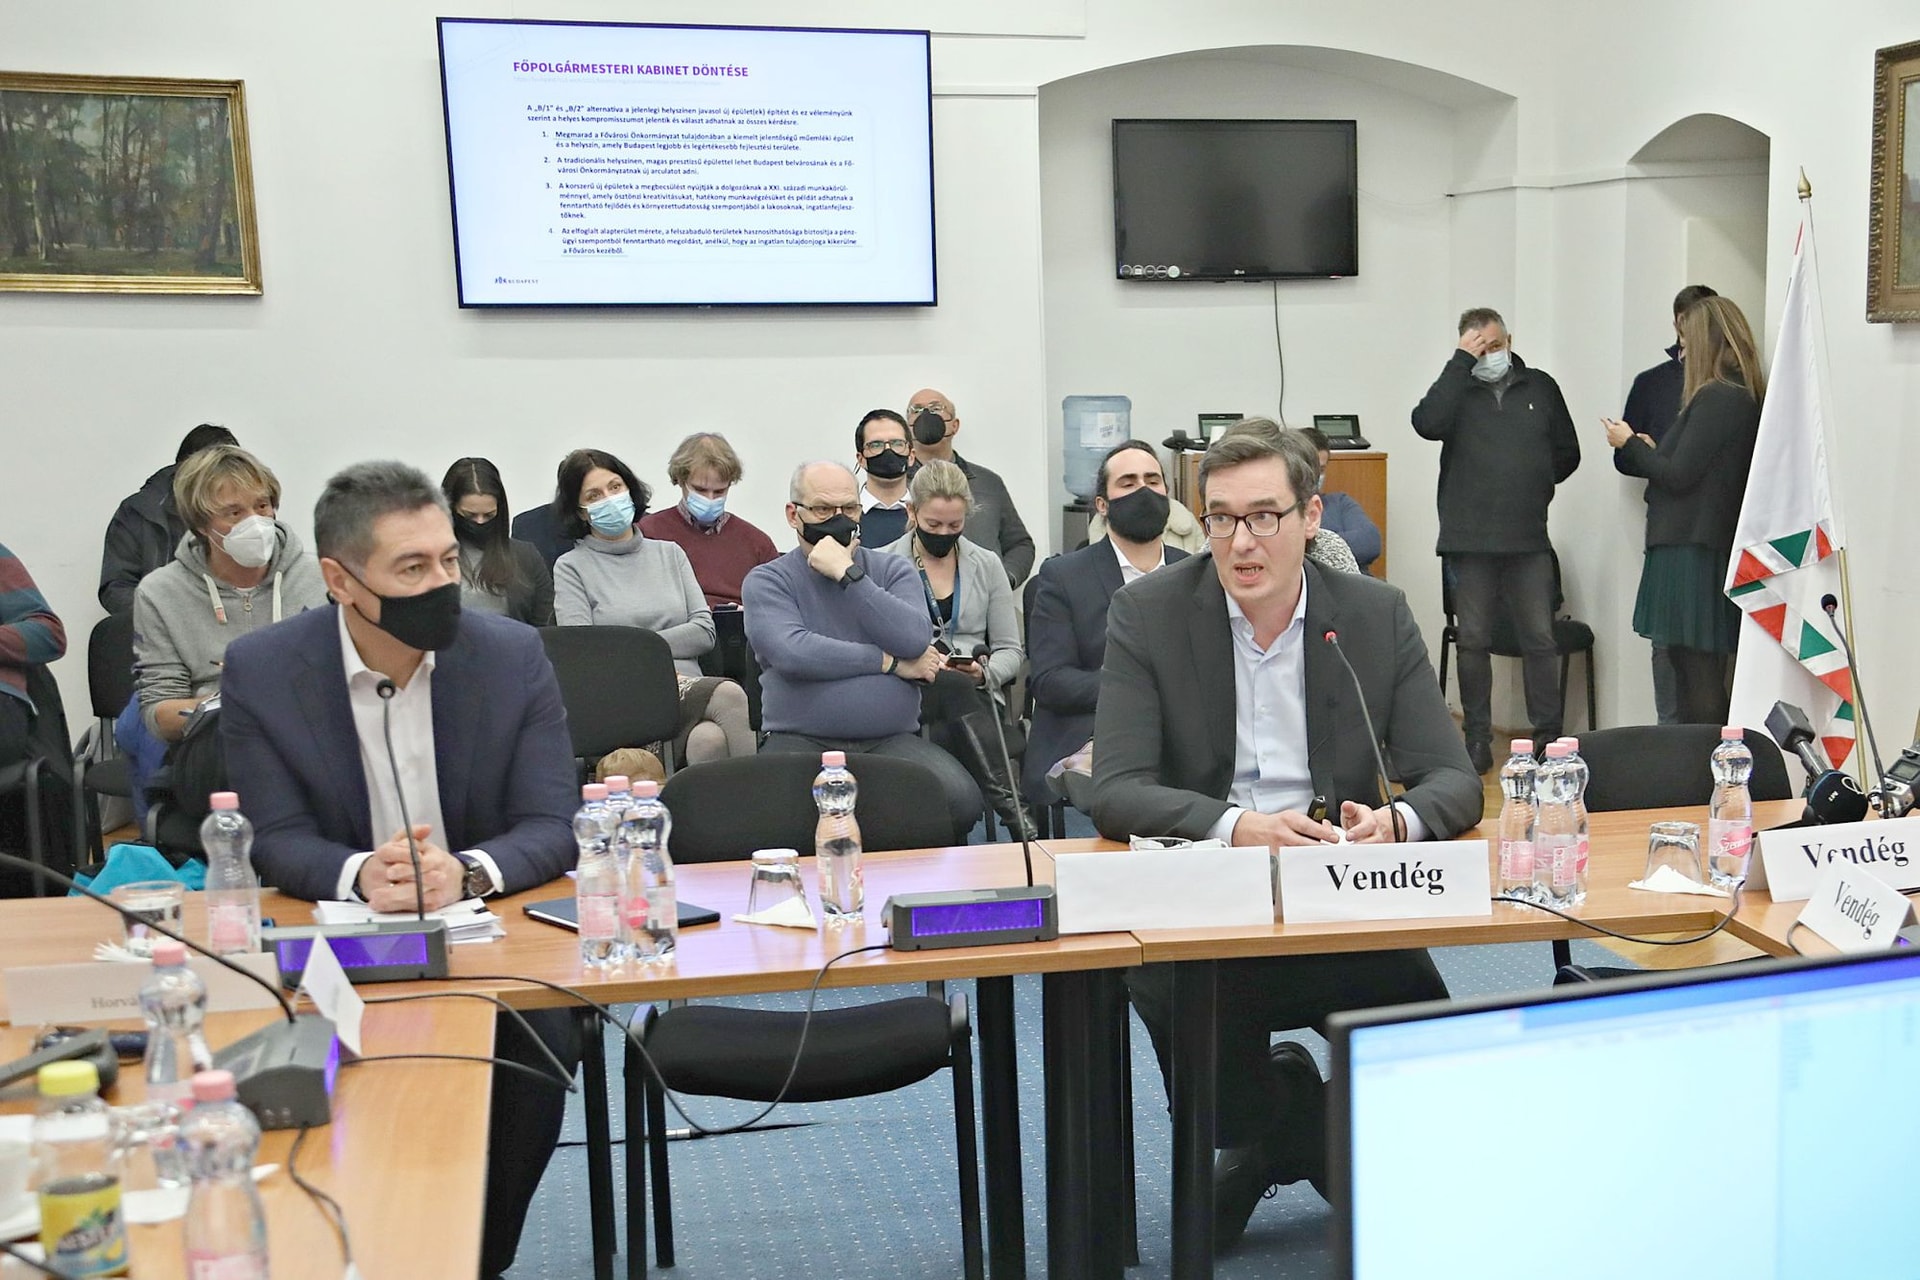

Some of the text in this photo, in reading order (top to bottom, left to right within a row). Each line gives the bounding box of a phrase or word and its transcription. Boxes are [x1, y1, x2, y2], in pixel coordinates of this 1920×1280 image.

[514, 60, 748, 77] FŐPOLGÁRMESTERI KABINET DÖNTÉSE
[1325, 861, 1444, 895] Vendég
[1834, 881, 1880, 940] Vendég
